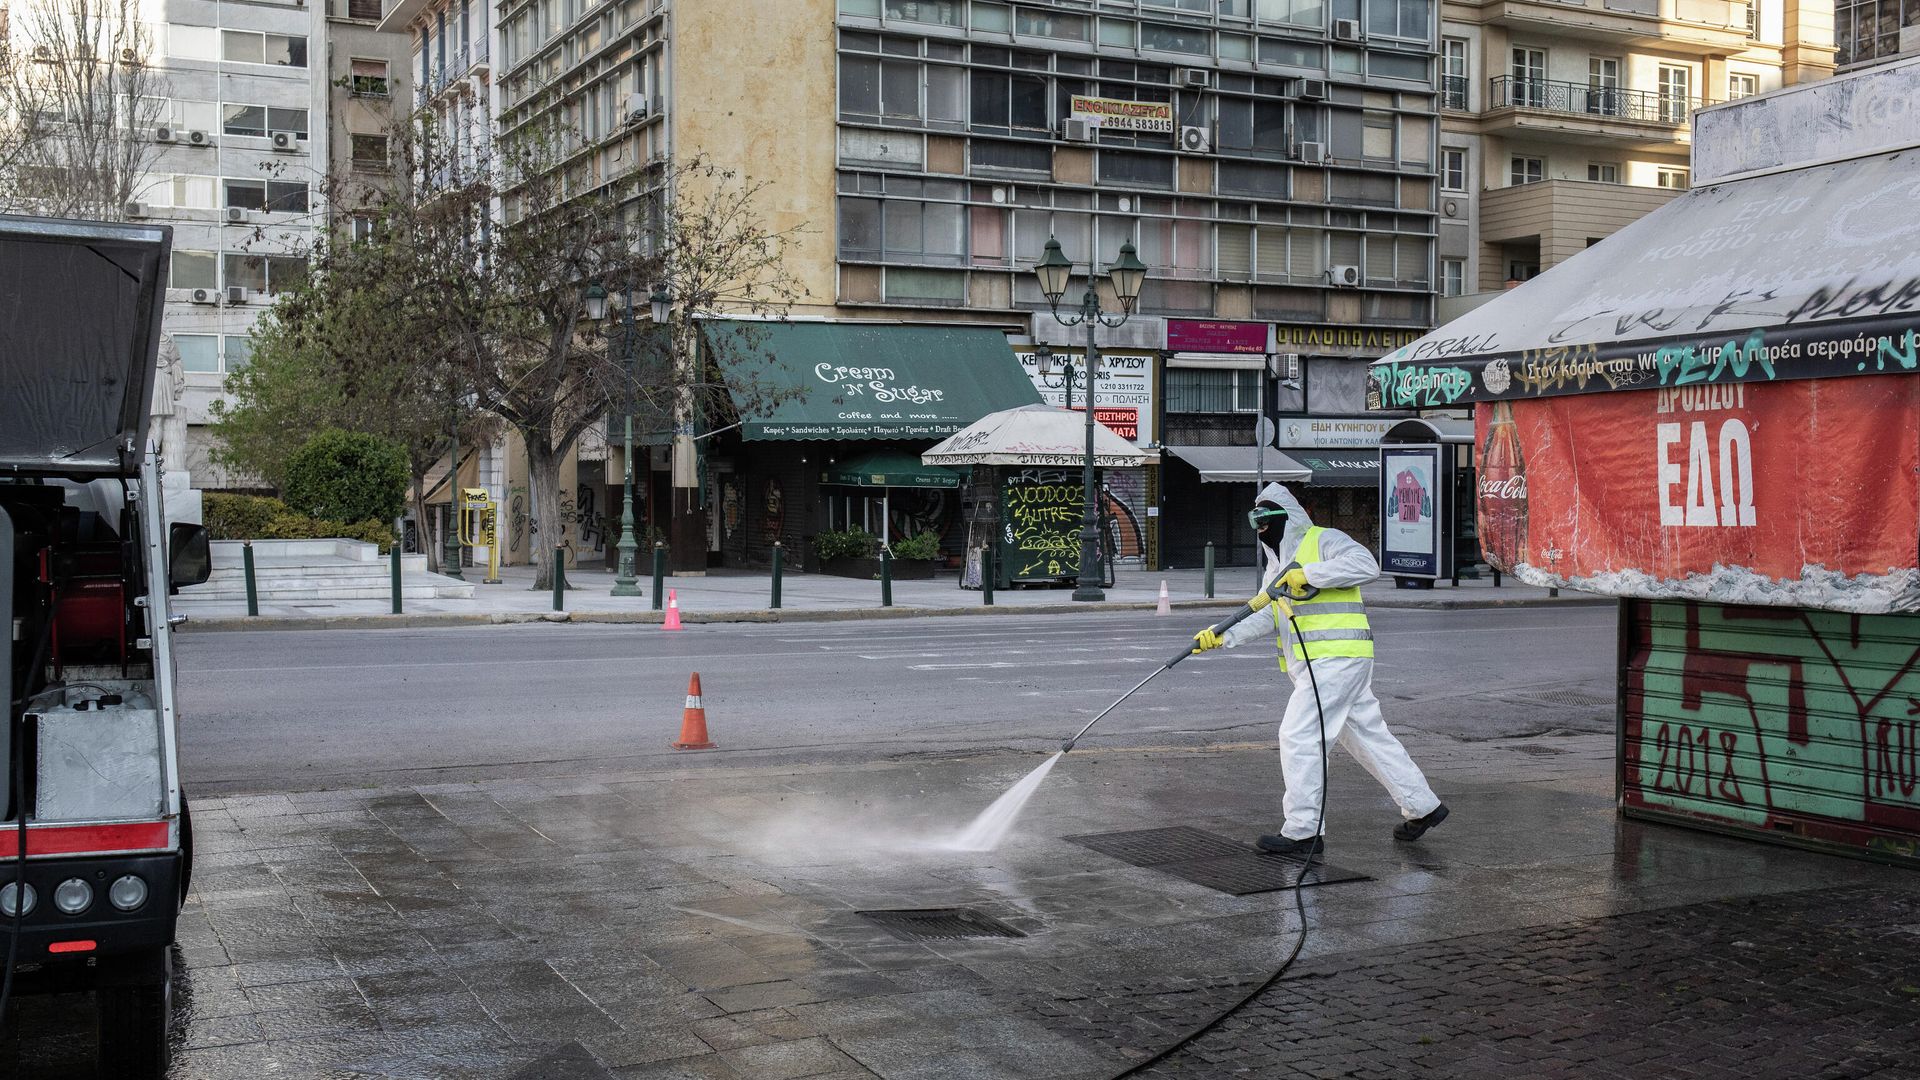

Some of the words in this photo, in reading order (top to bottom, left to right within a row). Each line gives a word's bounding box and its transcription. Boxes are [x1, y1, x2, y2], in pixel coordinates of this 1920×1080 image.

[1074, 99, 1170, 118] ΕΝΟΙΚΙΑΖΕΤΑΙ
[1108, 116, 1132, 129] 6944
[1135, 119, 1172, 132] 583815
[1109, 357, 1147, 369] ΧΡΥΣΟΥ
[1609, 358, 1633, 372] του
[814, 362, 895, 383] Cream
[868, 380, 944, 404] Sugar
[1112, 395, 1150, 404] ΠΩΛΗΣΗ
[838, 411, 872, 419] Coffee
[1094, 411, 1136, 421] ΝΕΙΣΤΗΡΙΟ
[791, 426, 830, 434] Sandwiches
[873, 426, 899, 435] Παγωτό
[935, 425, 951, 433] Draft
[1311, 423, 1332, 432] ΕΙΔΗ
[1335, 423, 1378, 433] ΚΥΝΗΓΙΟΥ
[1656, 418, 1757, 527] ΕΔΩ
[1654, 720, 1746, 804] 2018
